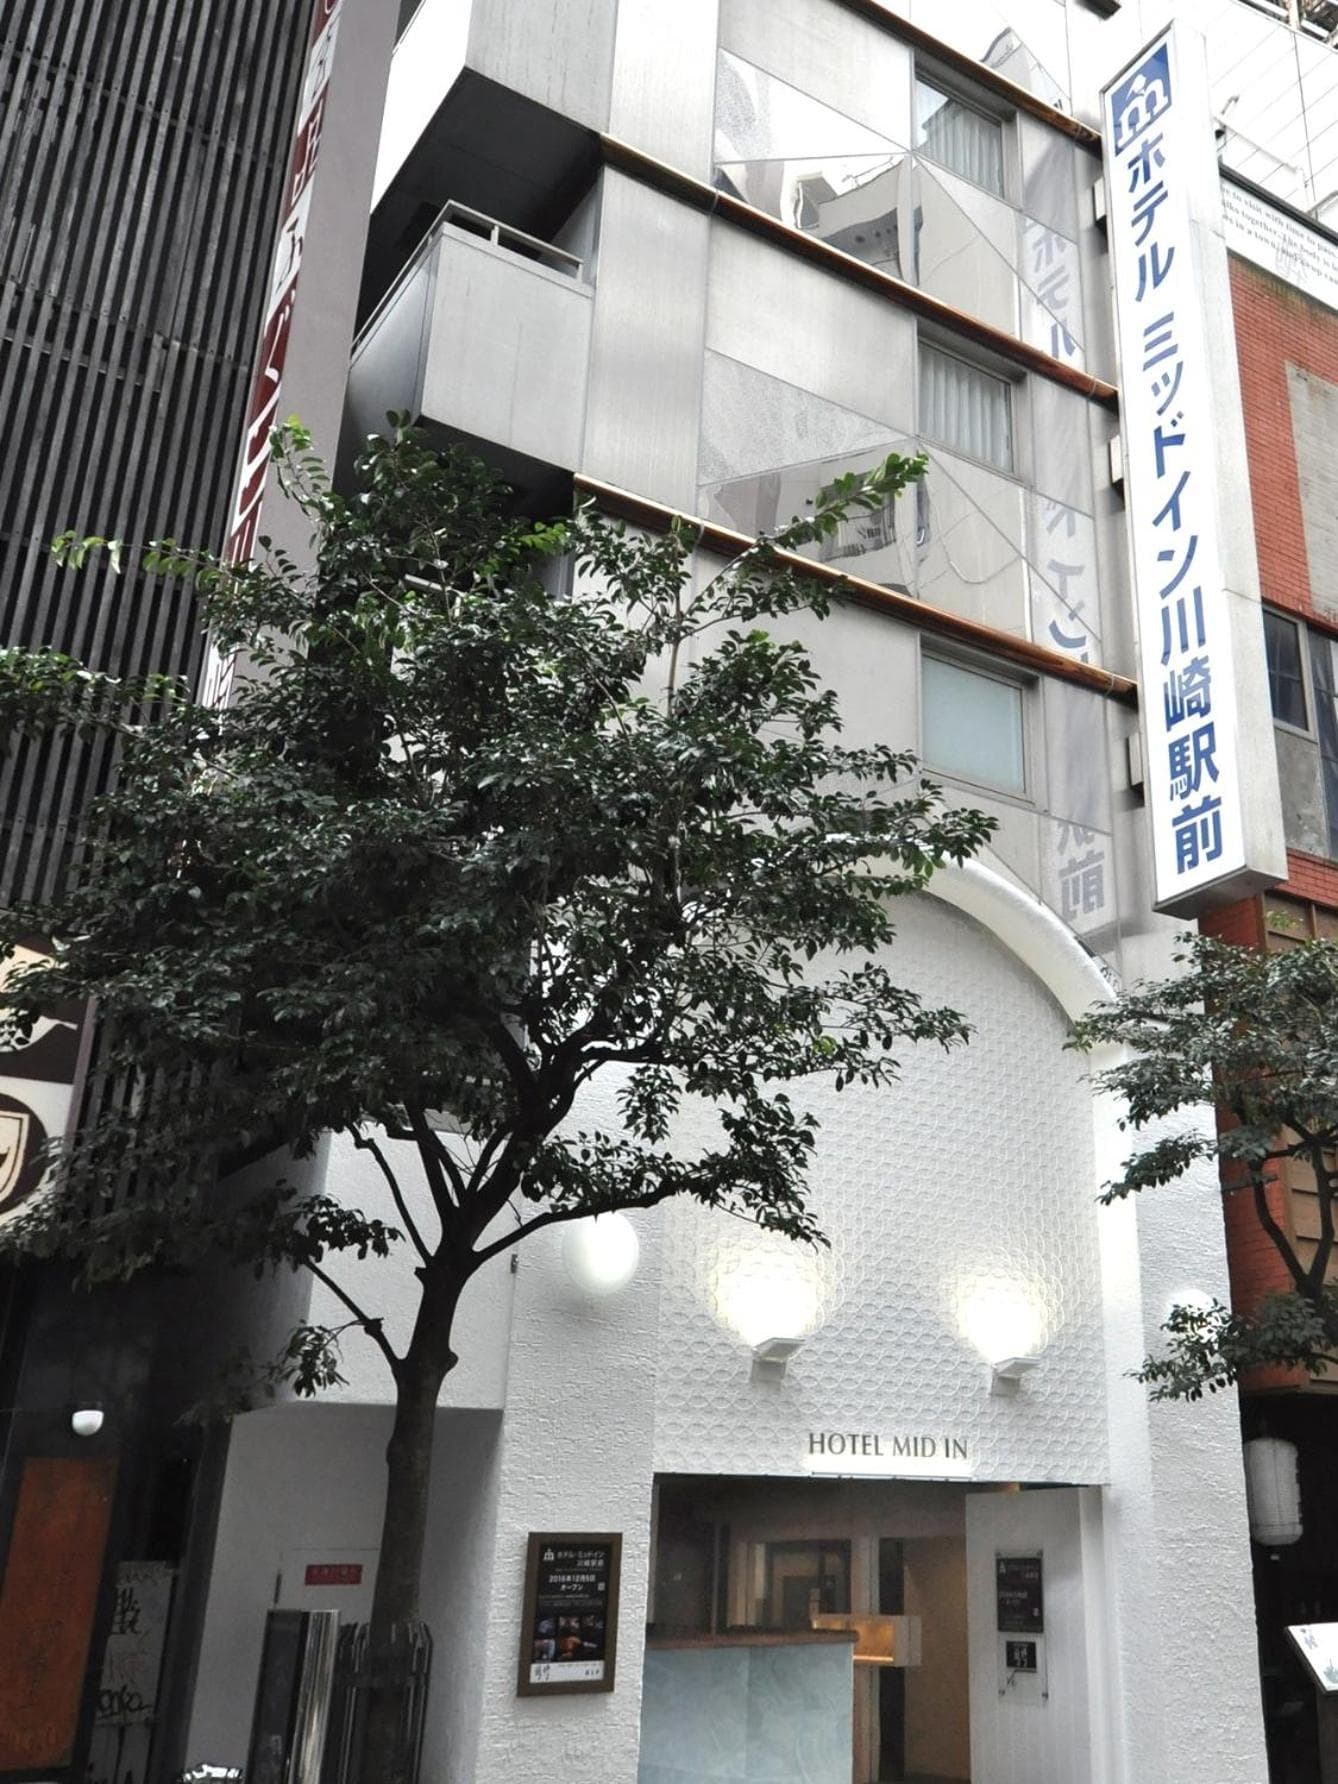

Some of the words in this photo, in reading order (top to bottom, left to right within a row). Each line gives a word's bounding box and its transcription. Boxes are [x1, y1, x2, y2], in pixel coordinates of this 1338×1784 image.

[1127, 132, 1176, 302] ホテル
[1142, 311, 1223, 876] ミッドイン川崎駅前
[809, 1432, 884, 1456] HOTEL
[892, 1436, 937, 1458] MID
[944, 1438, 968, 1459] IN
